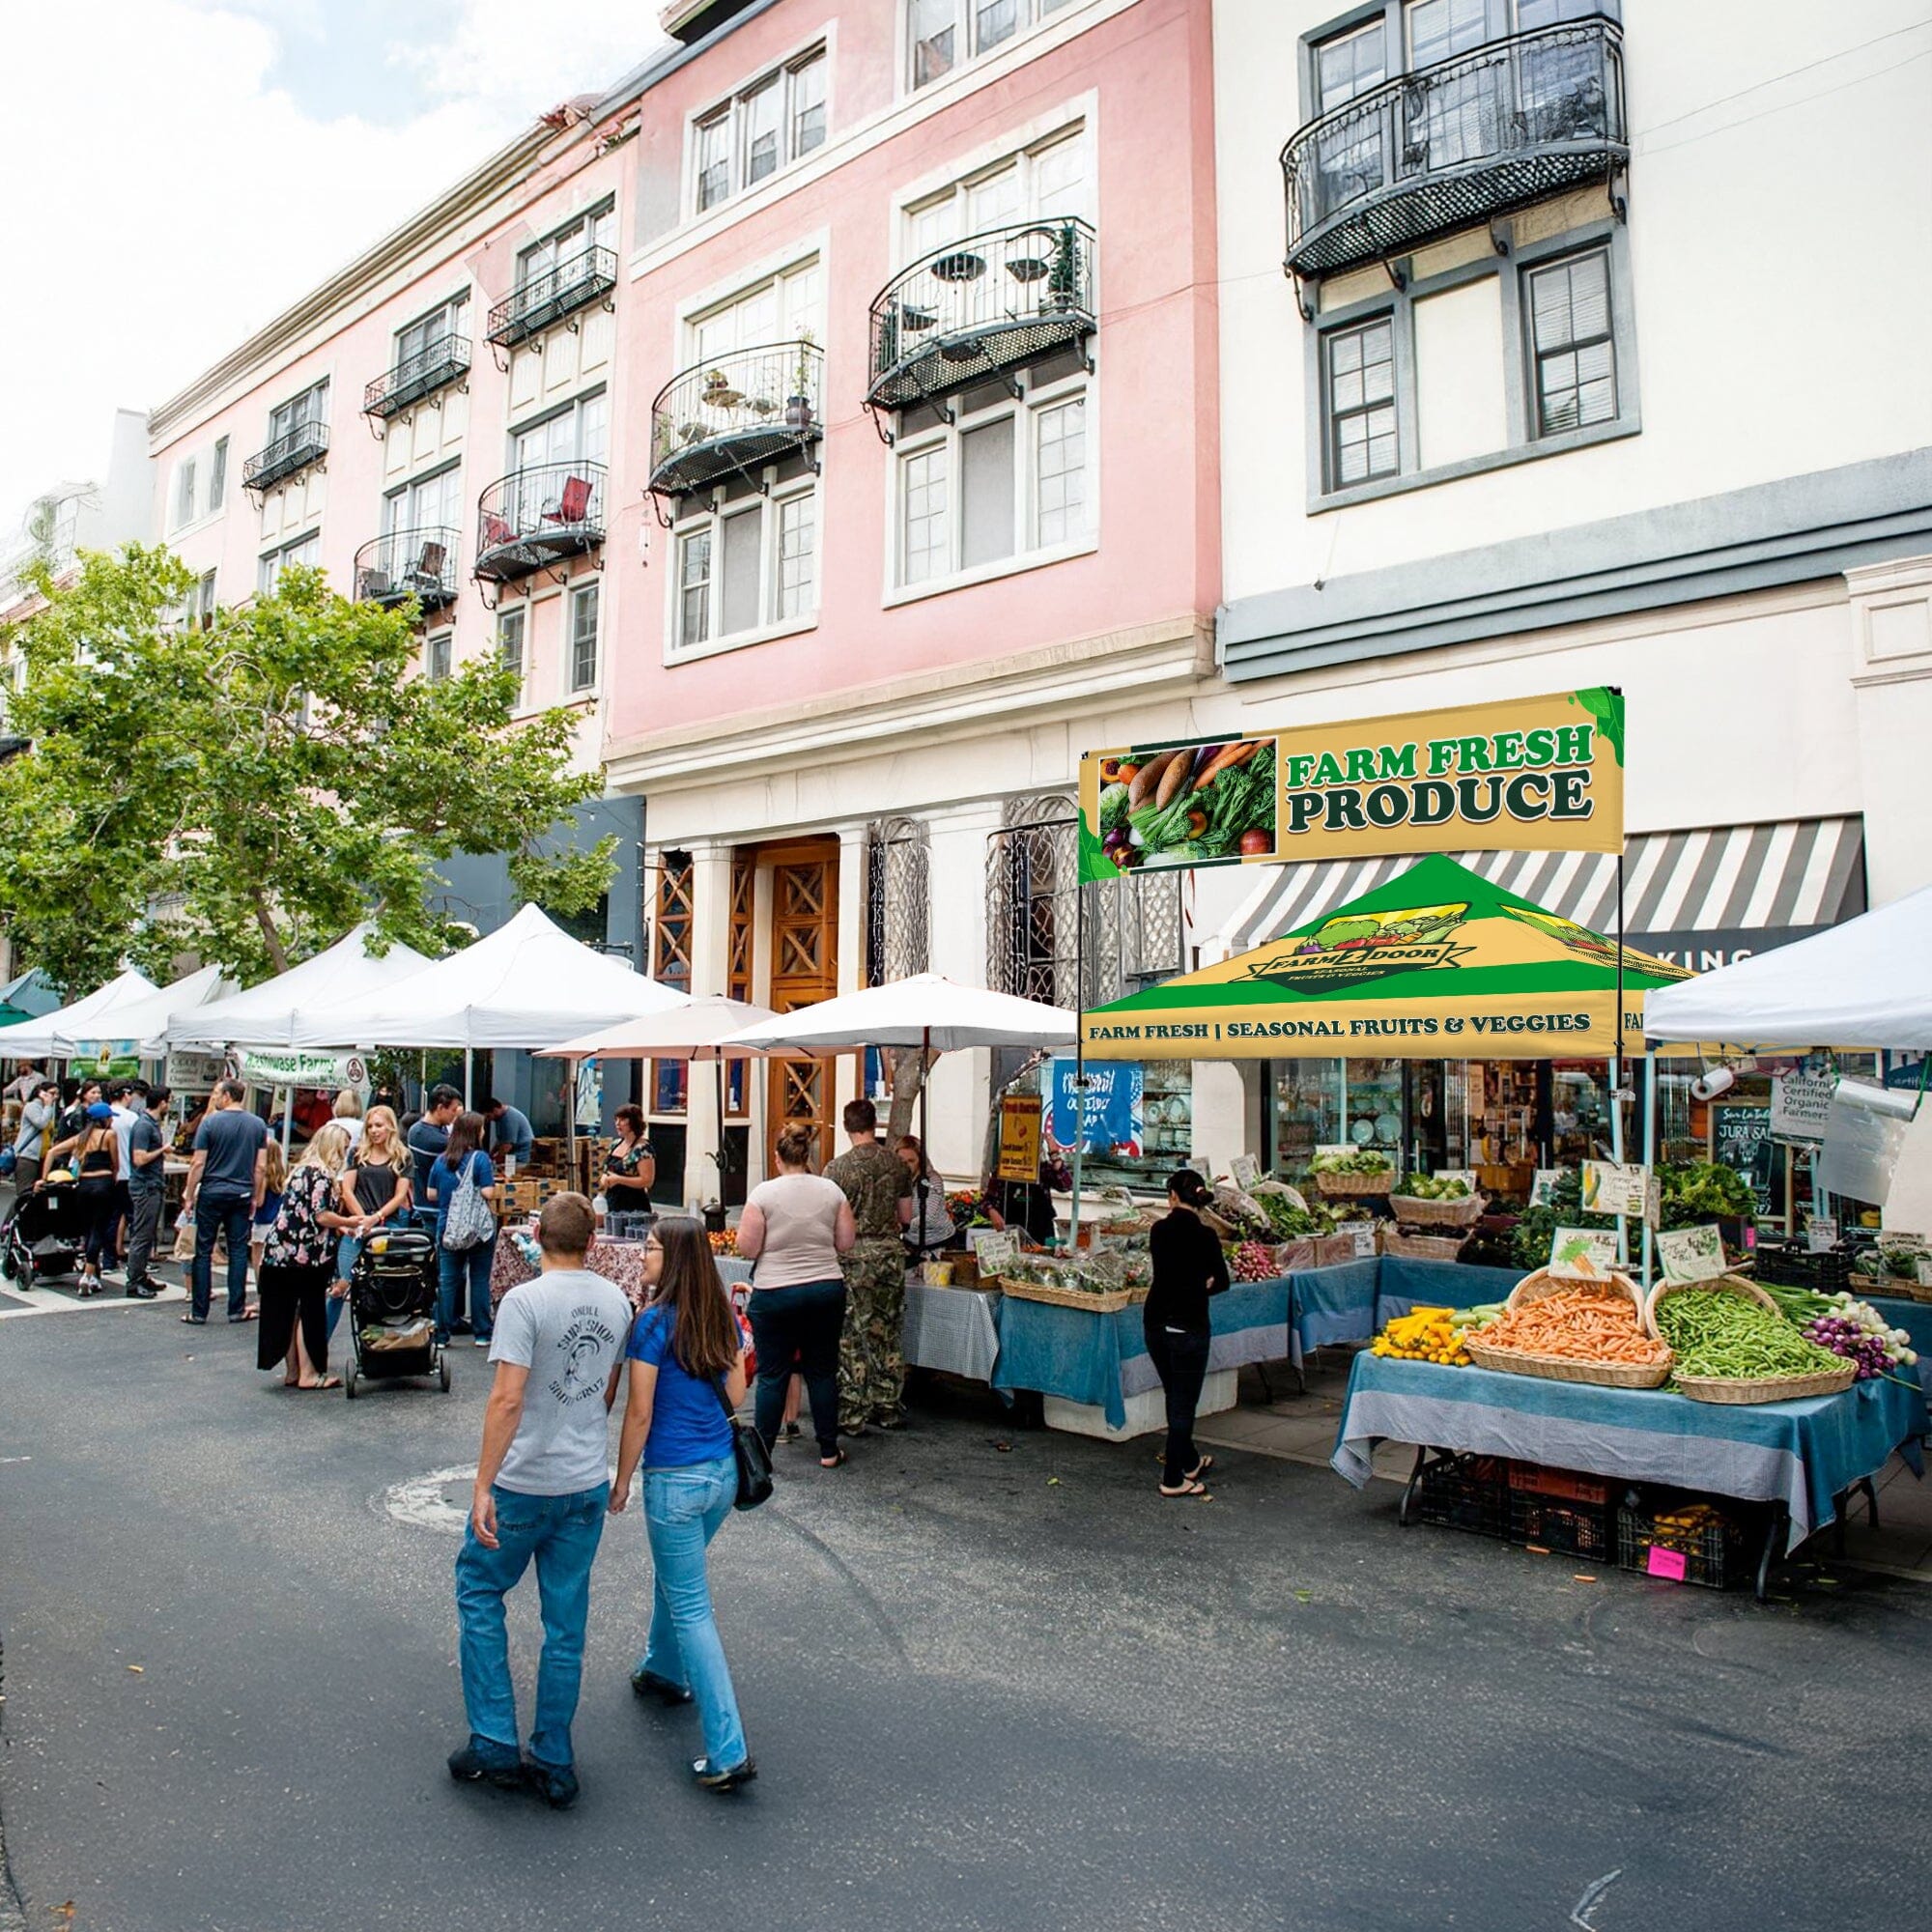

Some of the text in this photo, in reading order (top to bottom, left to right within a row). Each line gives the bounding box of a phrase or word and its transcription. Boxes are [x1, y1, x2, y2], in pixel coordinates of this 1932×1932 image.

[1286, 724, 1594, 789] FARM FRESH
[1286, 769, 1595, 834] PRODUCE
[1269, 953, 1337, 970] FARM
[1368, 949, 1440, 961] DOOR
[1089, 1026, 1141, 1039] FARM
[1144, 1024, 1208, 1038] FRESH
[1227, 1019, 1346, 1038] SEASONAL
[1350, 1017, 1439, 1037] FRUITS
[1443, 1017, 1465, 1035] &
[1470, 1012, 1592, 1035] VEGGIES
[298, 1053, 337, 1073] Farms
[1780, 1074, 1833, 1088] Californi
[1782, 1084, 1833, 1099] Certified
[1784, 1095, 1831, 1110] Organic
[1719, 1124, 1749, 1139] JURA
[585, 1319, 615, 1345] SHOP
